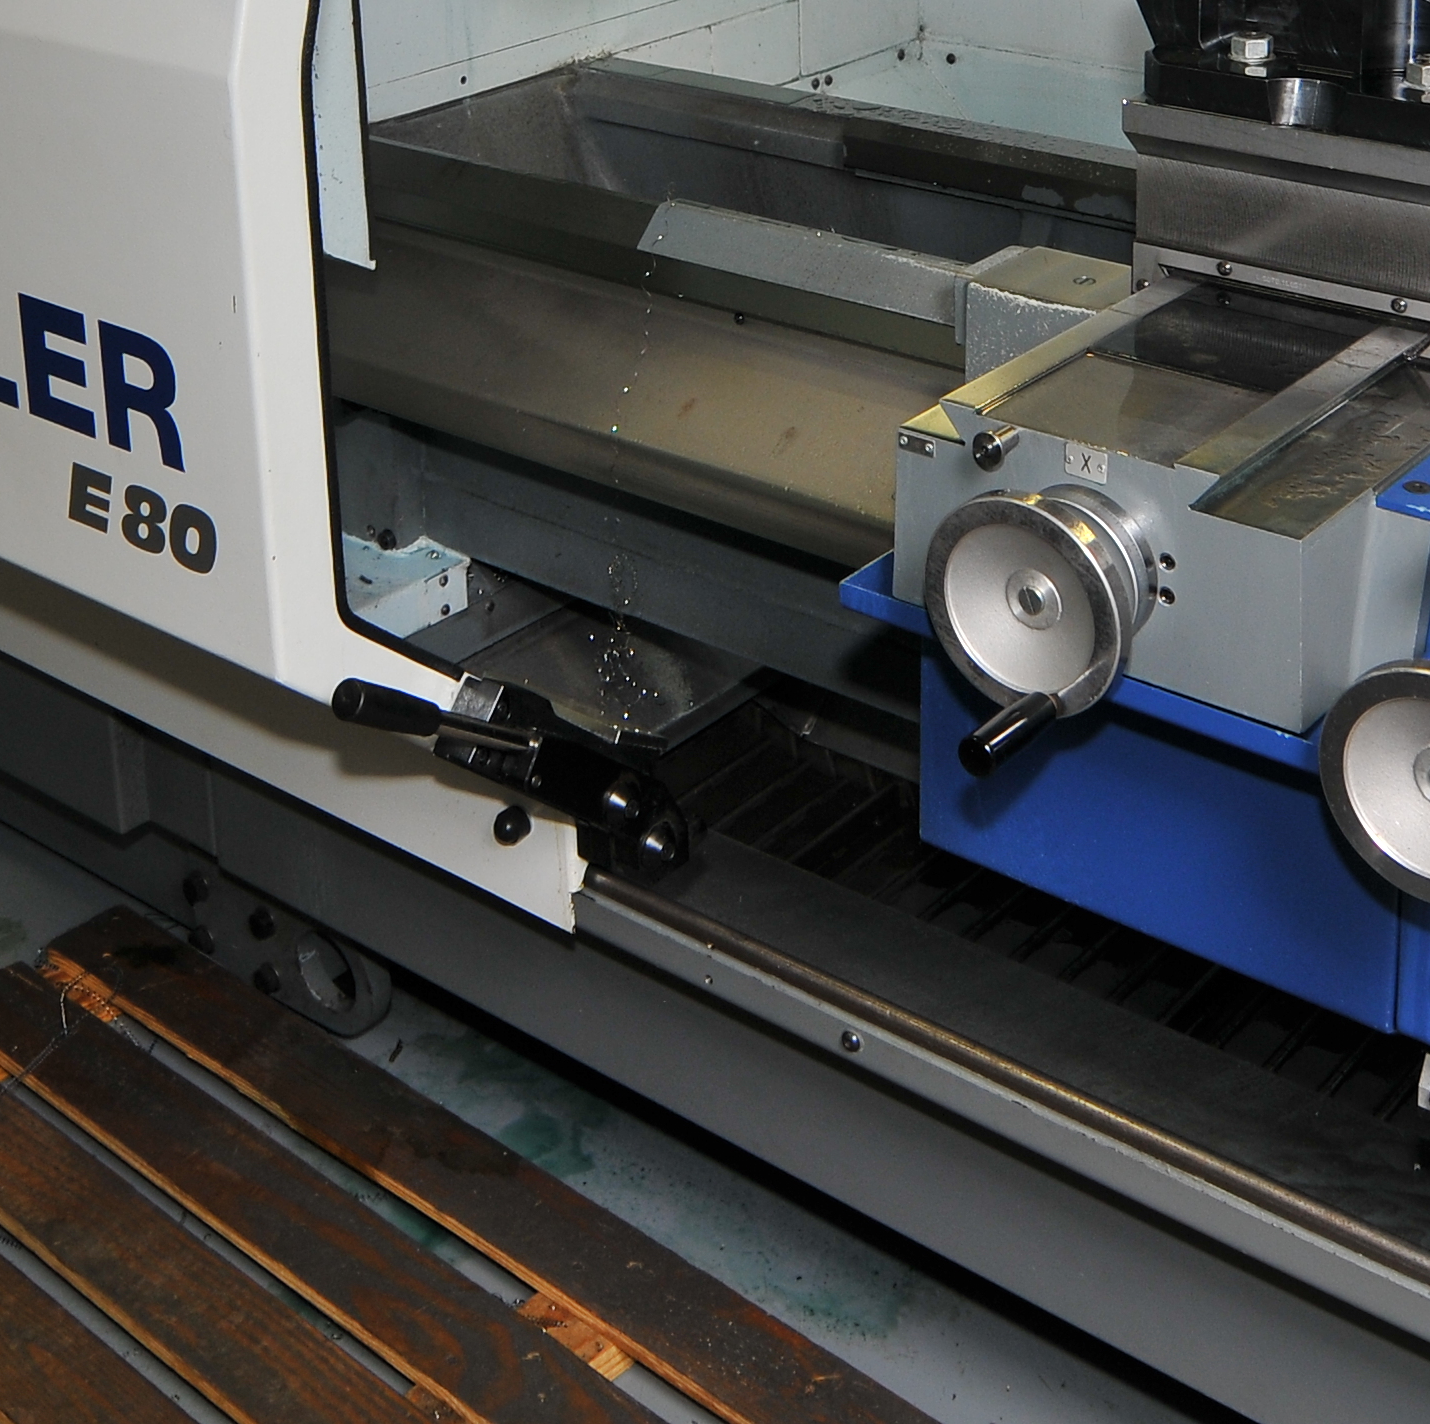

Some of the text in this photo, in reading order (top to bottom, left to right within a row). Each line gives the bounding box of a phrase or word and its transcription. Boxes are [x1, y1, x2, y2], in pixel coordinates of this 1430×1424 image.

[1081, 452, 1091, 474] X
[68, 462, 217, 574] E 80
